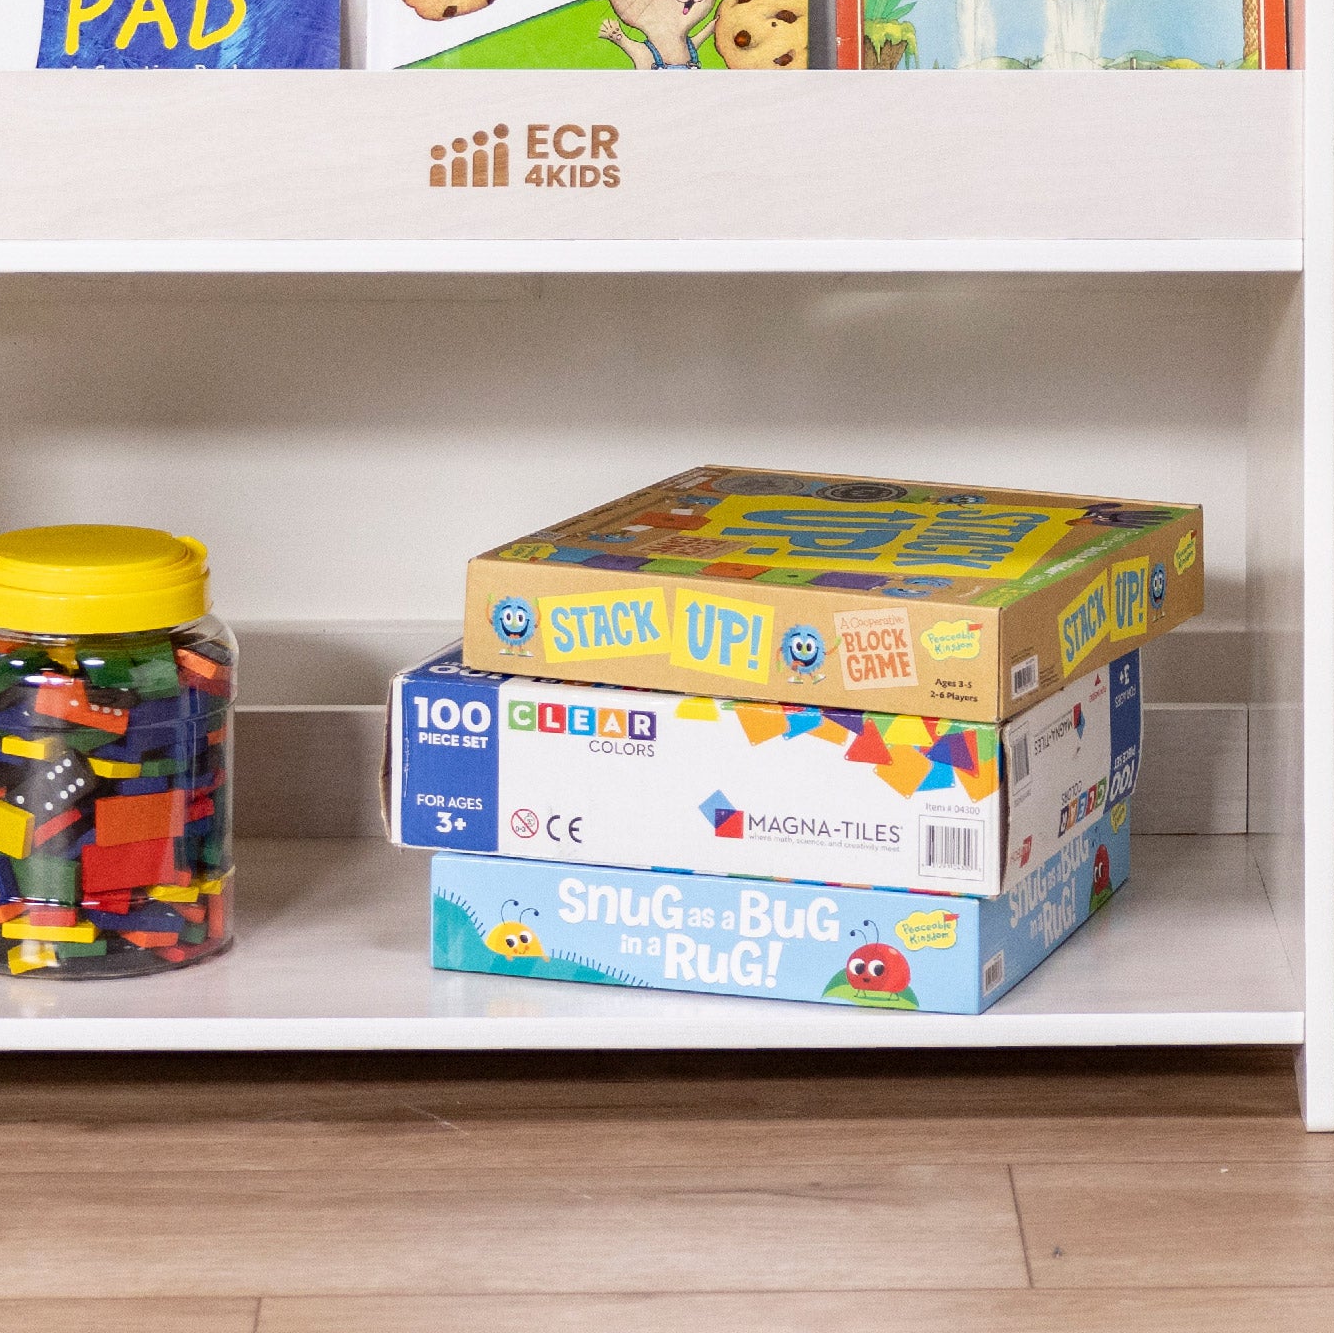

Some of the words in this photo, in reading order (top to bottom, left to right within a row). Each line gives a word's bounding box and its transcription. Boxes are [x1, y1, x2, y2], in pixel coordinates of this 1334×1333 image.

[527, 124, 620, 159] ECR
[525, 164, 621, 189] 4KIDS
[840, 617, 850, 630] A
[850, 614, 905, 629] Cooperative
[1063, 586, 1107, 663] STACK
[1115, 568, 1145, 630] UP!
[550, 600, 661, 653] STACK
[685, 601, 763, 670] UP!
[841, 628, 909, 653] BLOCK
[927, 631, 976, 644] Peaceable
[934, 642, 973, 655] Kingdom
[846, 651, 912, 683] GAME
[935, 678, 956, 688] Ages
[958, 680, 972, 688] 3-5
[930, 690, 944, 699] 2-6
[946, 692, 978, 703] Players
[413, 696, 491, 733] 100
[511, 702, 652, 738] CLEAR
[418, 731, 459, 746] PIECE
[462, 735, 489, 749] SET
[589, 739, 655, 757] COLORS
[417, 794, 444, 807] FOR
[448, 796, 483, 811] AGES
[925, 802, 946, 812] Item
[435, 811, 467, 833] 3+
[828, 839, 843, 847] and
[687, 906, 715, 928] as
[721, 910, 736, 930] a
[902, 915, 952, 934] Peaceable
[620, 934, 644, 955] in
[647, 939, 661, 957] a
[909, 931, 950, 945] Kingdom
